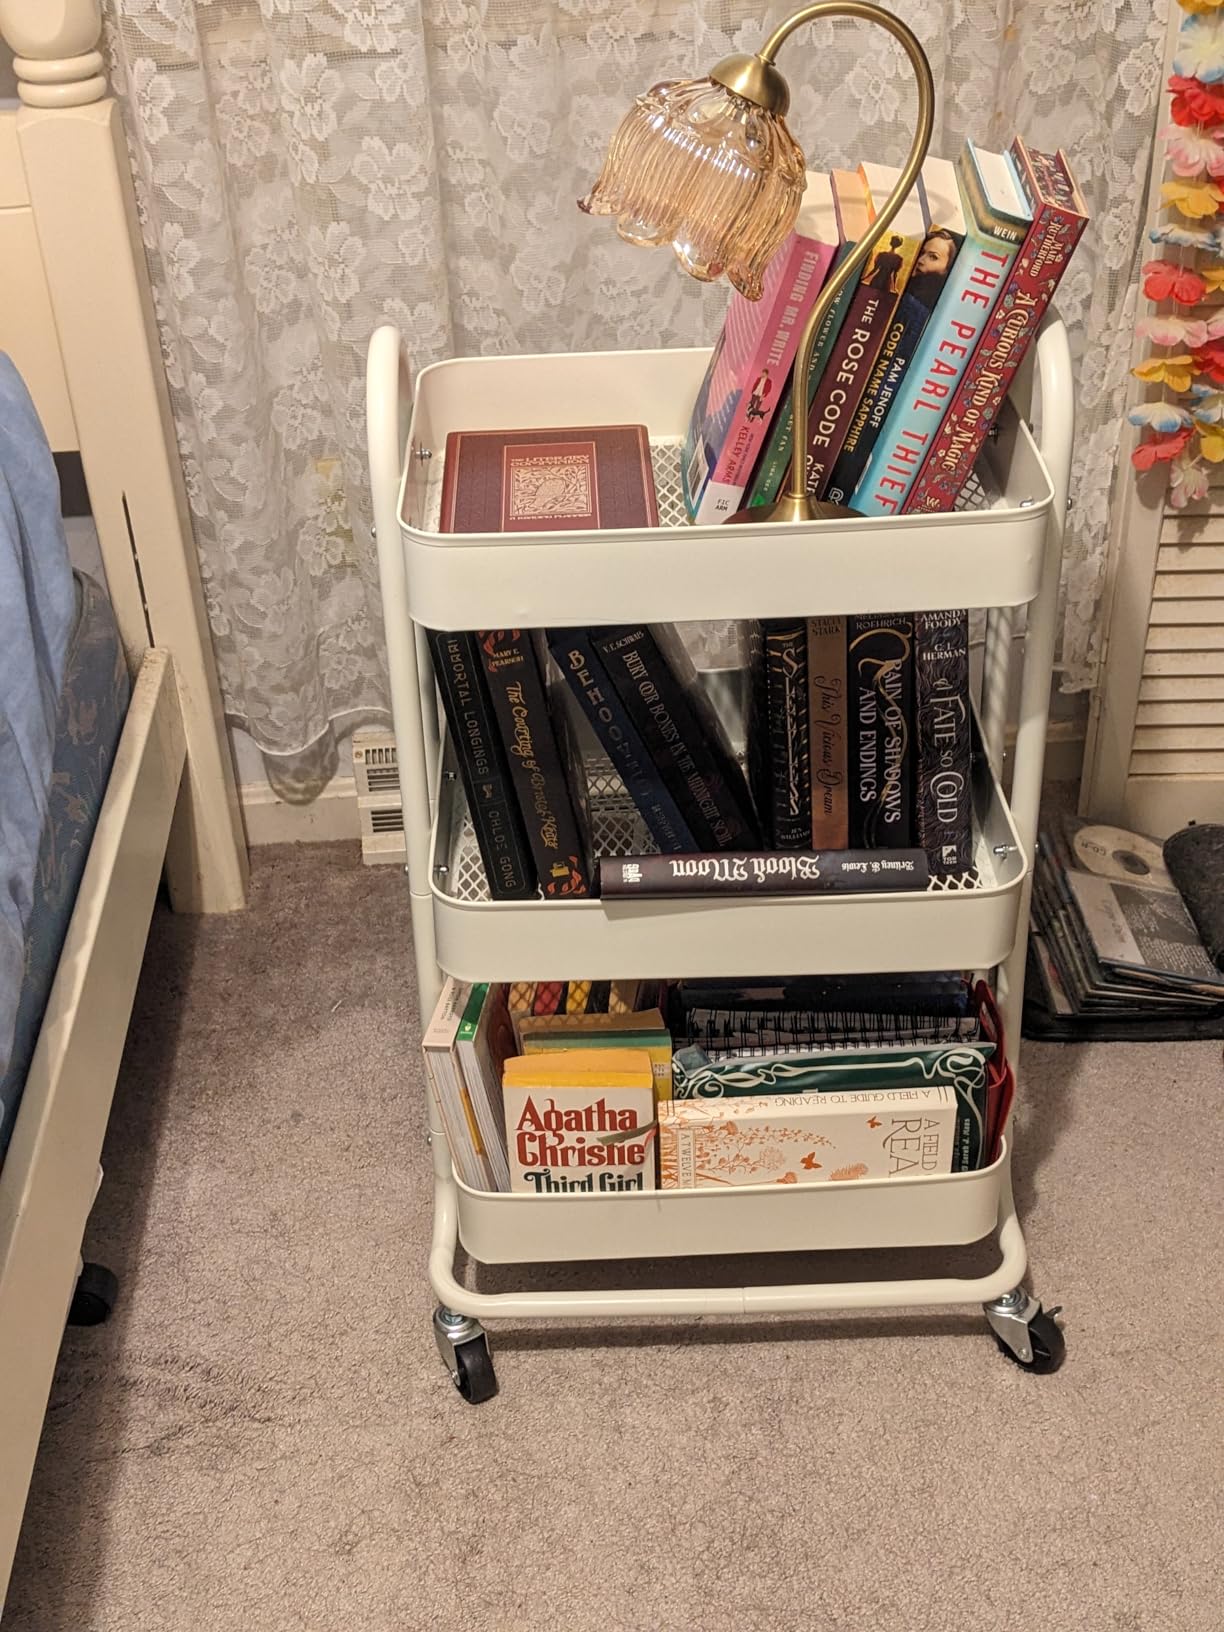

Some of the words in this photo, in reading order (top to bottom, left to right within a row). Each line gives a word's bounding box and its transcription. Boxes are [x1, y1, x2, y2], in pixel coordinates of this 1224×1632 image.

[993, 225, 1018, 241] WEIN
[1029, 220, 1062, 278] RUTHERFORD
[1043, 241, 1066, 265] MARA
[789, 250, 819, 303] FINDING
[960, 249, 1009, 310] THE
[860, 299, 880, 325] THE
[1012, 288, 1038, 307] A
[779, 304, 800, 329] MR.
[817, 307, 836, 348] FLOWER
[766, 329, 791, 367] WRITE
[835, 327, 871, 386] ROSE
[883, 322, 905, 358] CODE
[987, 308, 1029, 371] CURIOUS
[808, 351, 820, 371] AND
[866, 358, 890, 396] NAME
[886, 356, 906, 384] PAM
[912, 319, 977, 412] PEARL
[971, 365, 1003, 406] KIND
[812, 388, 847, 448] CODE
[843, 397, 874, 453] SAPPHIRE
[868, 384, 894, 429] JENOFF
[962, 408, 980, 428] OF
[734, 425, 750, 457] KELLEY
[940, 424, 975, 473] MAGIC
[873, 429, 929, 515] THIEF
[812, 625, 842, 636] STARK
[856, 617, 906, 630] ROEHRICH
[921, 609, 967, 621] AMANDA
[924, 617, 962, 631] FOODY
[922, 648, 967, 661] HERMAN
[505, 680, 526, 705] The
[814, 675, 843, 711] This
[883, 660, 903, 700] RAIN
[446, 639, 473, 706] IMMORTAL
[463, 711, 490, 777] LONGINGS
[858, 687, 878, 724] AND
[883, 706, 902, 731] OF
[930, 694, 966, 747] FATE
[510, 705, 535, 758] Courting
[622, 649, 649, 680] BURY
[649, 702, 681, 742] BONES
[686, 770, 721, 820] MIDNIGHT
[710, 818, 734, 847] SOIL
[814, 713, 842, 764] Vicious
[521, 758, 541, 774] of
[859, 730, 878, 802] ENDINGS
[882, 736, 902, 823] SHADOWS
[816, 768, 842, 814] Dream
[930, 770, 965, 823] COLD
[540, 813, 559, 850] Keats
[499, 855, 518, 889] GONG
[669, 857, 749, 882] Moon
[750, 855, 821, 883] Blood
[841, 860, 868, 874] Lewis
[881, 859, 915, 872] Britney
[774, 1097, 827, 1107] READING
[850, 1093, 884, 1103] GUIDE
[886, 1091, 918, 1101] FIELD
[922, 1089, 932, 1098] A
[514, 1095, 638, 1146] Agatha
[924, 1117, 941, 1131] A
[680, 1141, 692, 1178] TWELVE
[882, 1116, 923, 1176] REA
[921, 1133, 940, 1171] FIELD
[523, 1168, 594, 1193] Third
[599, 1171, 643, 1192] Girl
